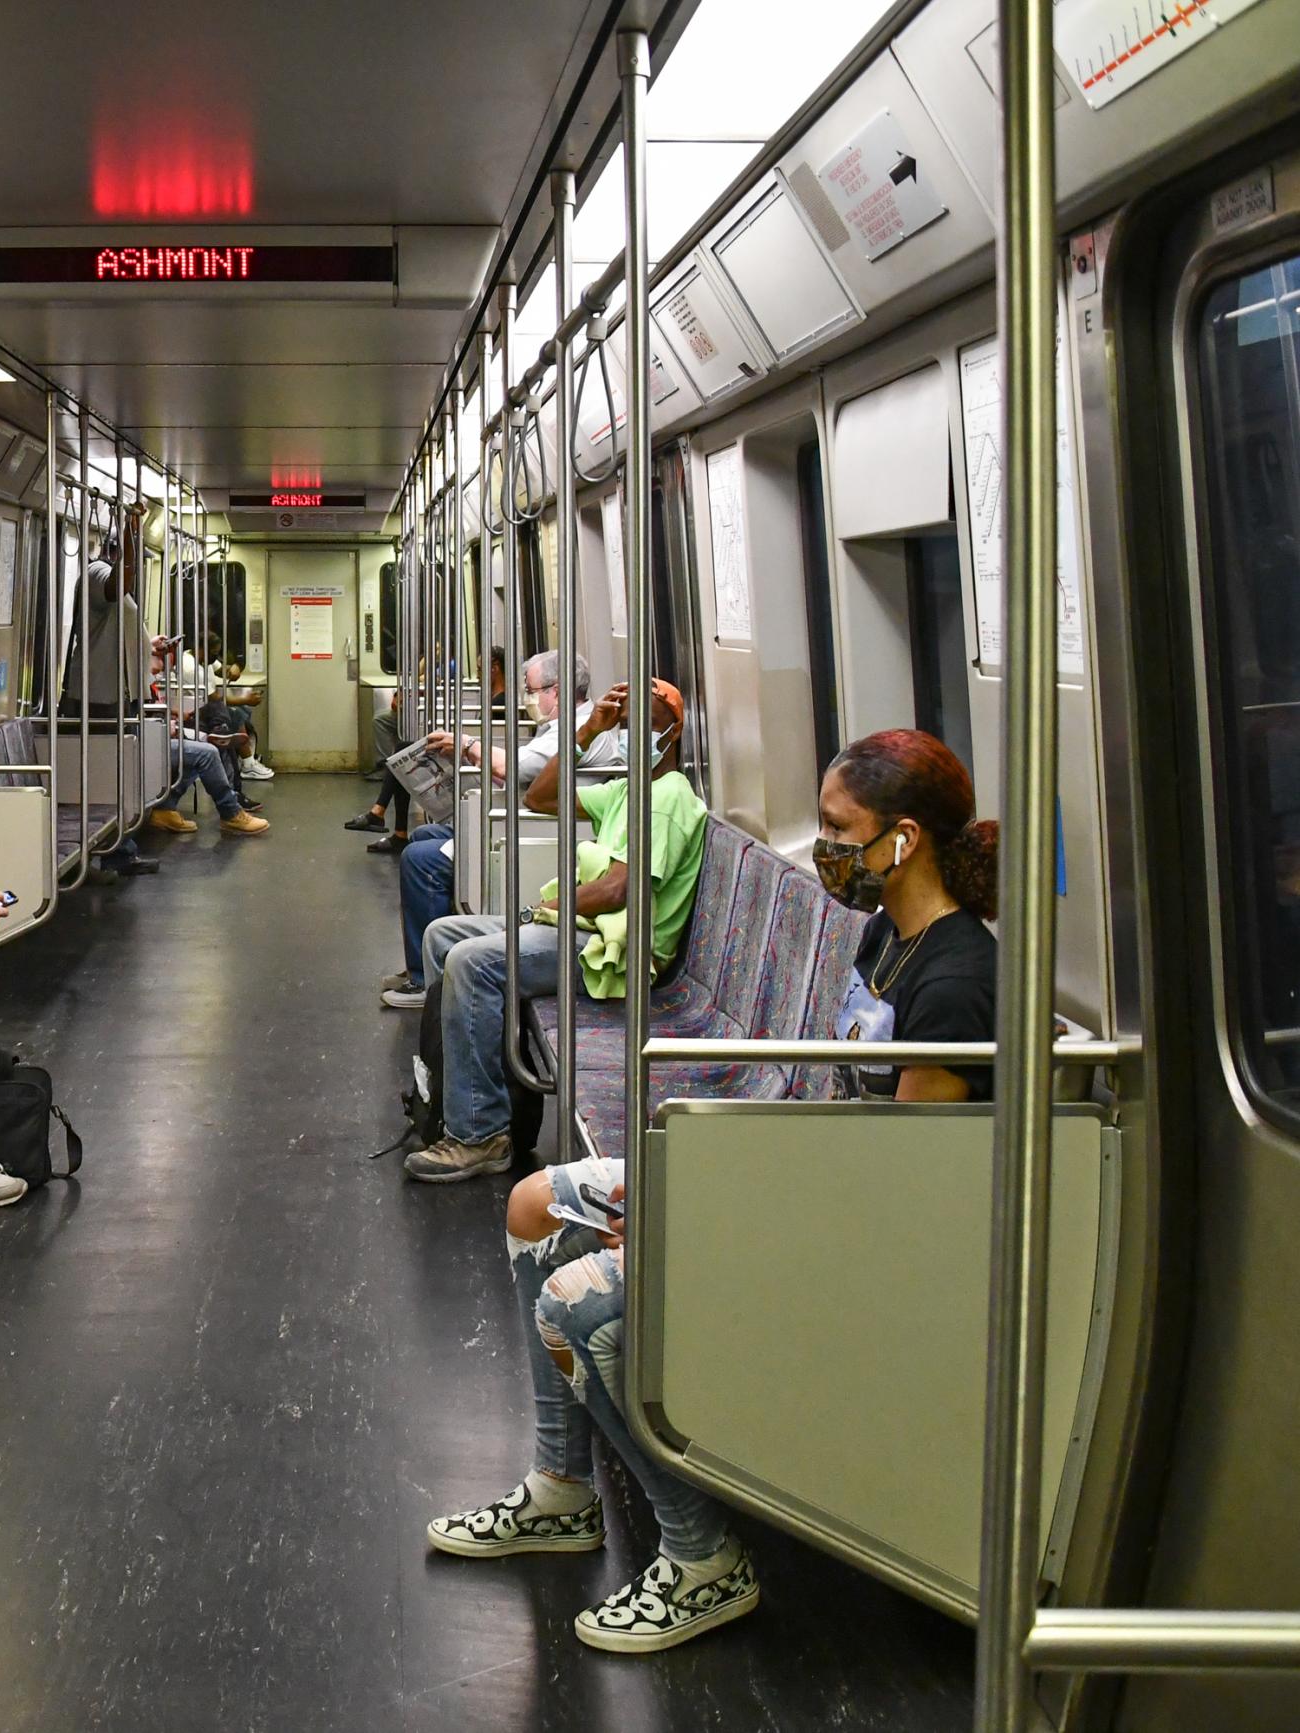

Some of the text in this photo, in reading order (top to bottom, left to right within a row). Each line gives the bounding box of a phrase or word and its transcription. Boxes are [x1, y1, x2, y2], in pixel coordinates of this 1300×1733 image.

[97, 248, 253, 278] ASHMONT
[1084, 309, 1092, 333] E
[271, 494, 322, 506] ASHMONT
